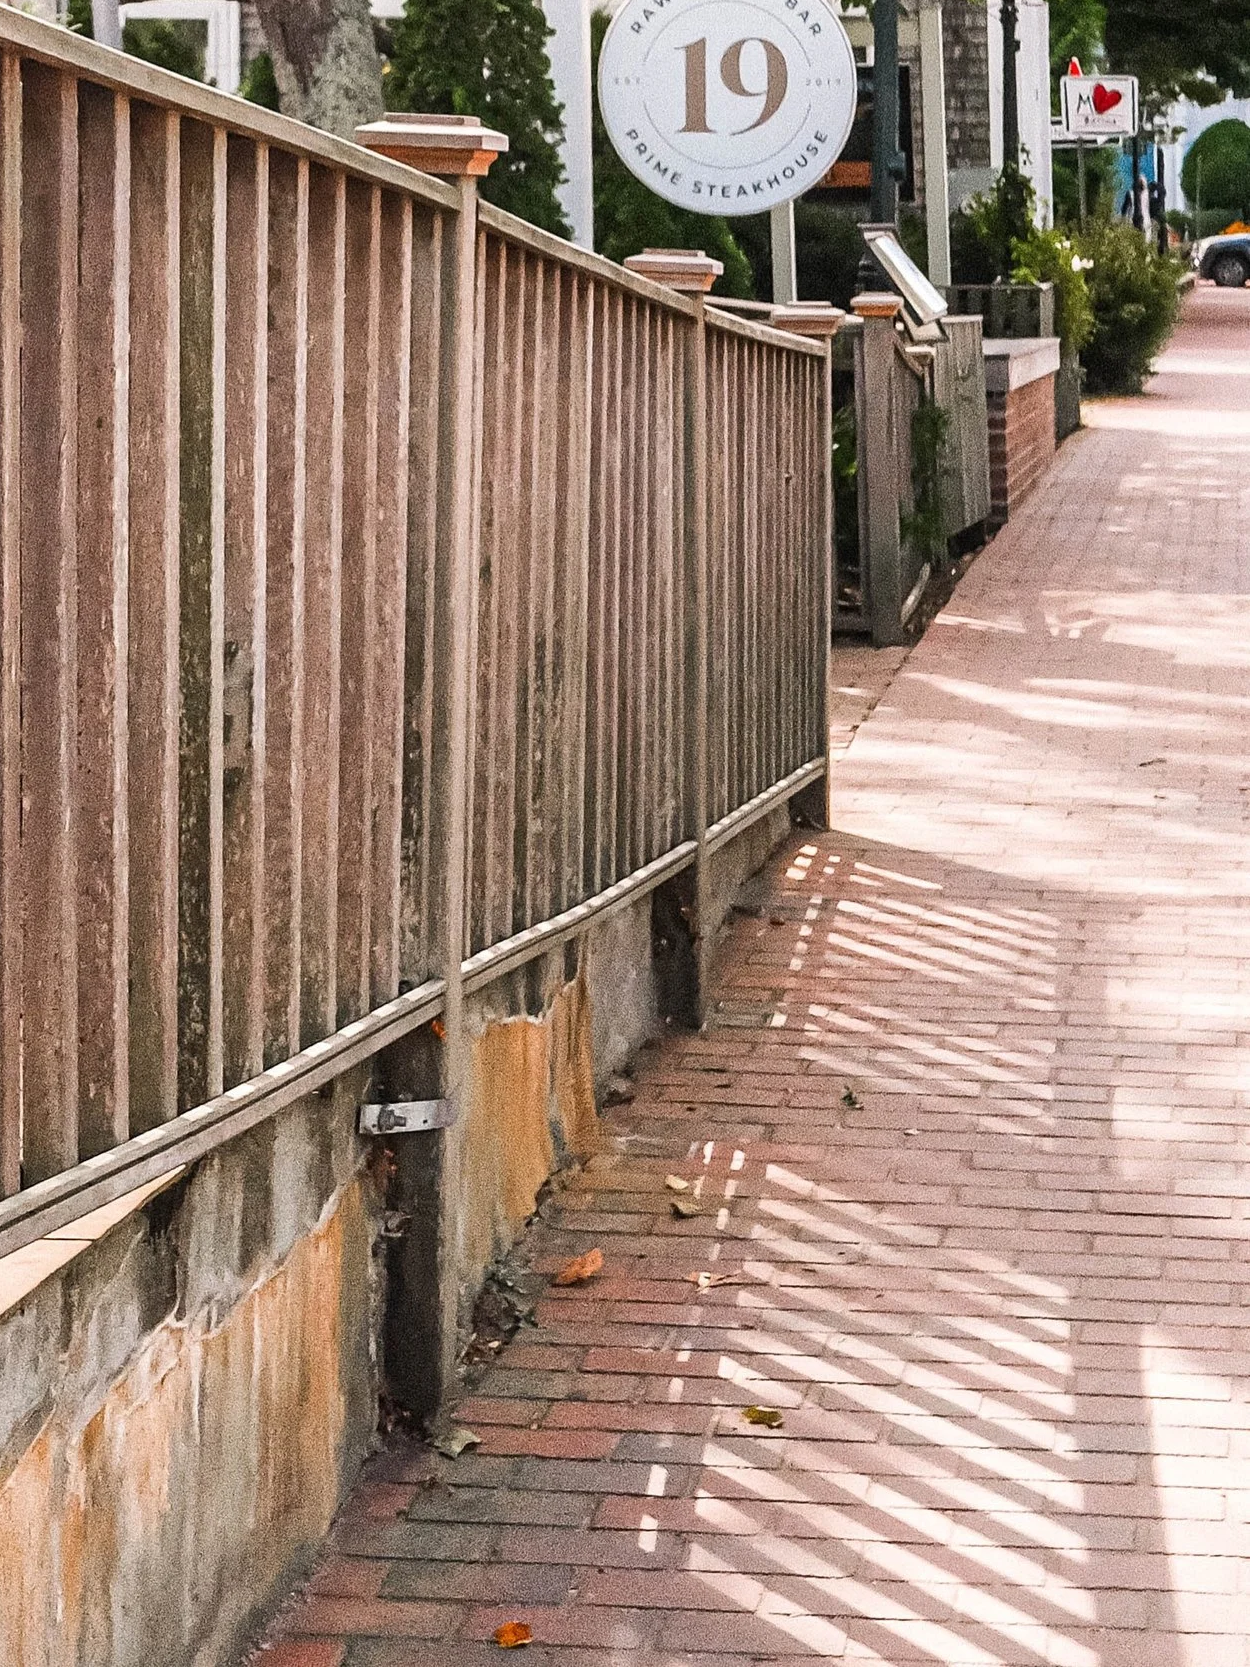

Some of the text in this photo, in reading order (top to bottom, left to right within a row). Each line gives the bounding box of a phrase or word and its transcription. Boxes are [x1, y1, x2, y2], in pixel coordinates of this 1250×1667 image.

[673, 36, 789, 137] 19
[626, 128, 829, 199] PRIME STEAKHOUSE
